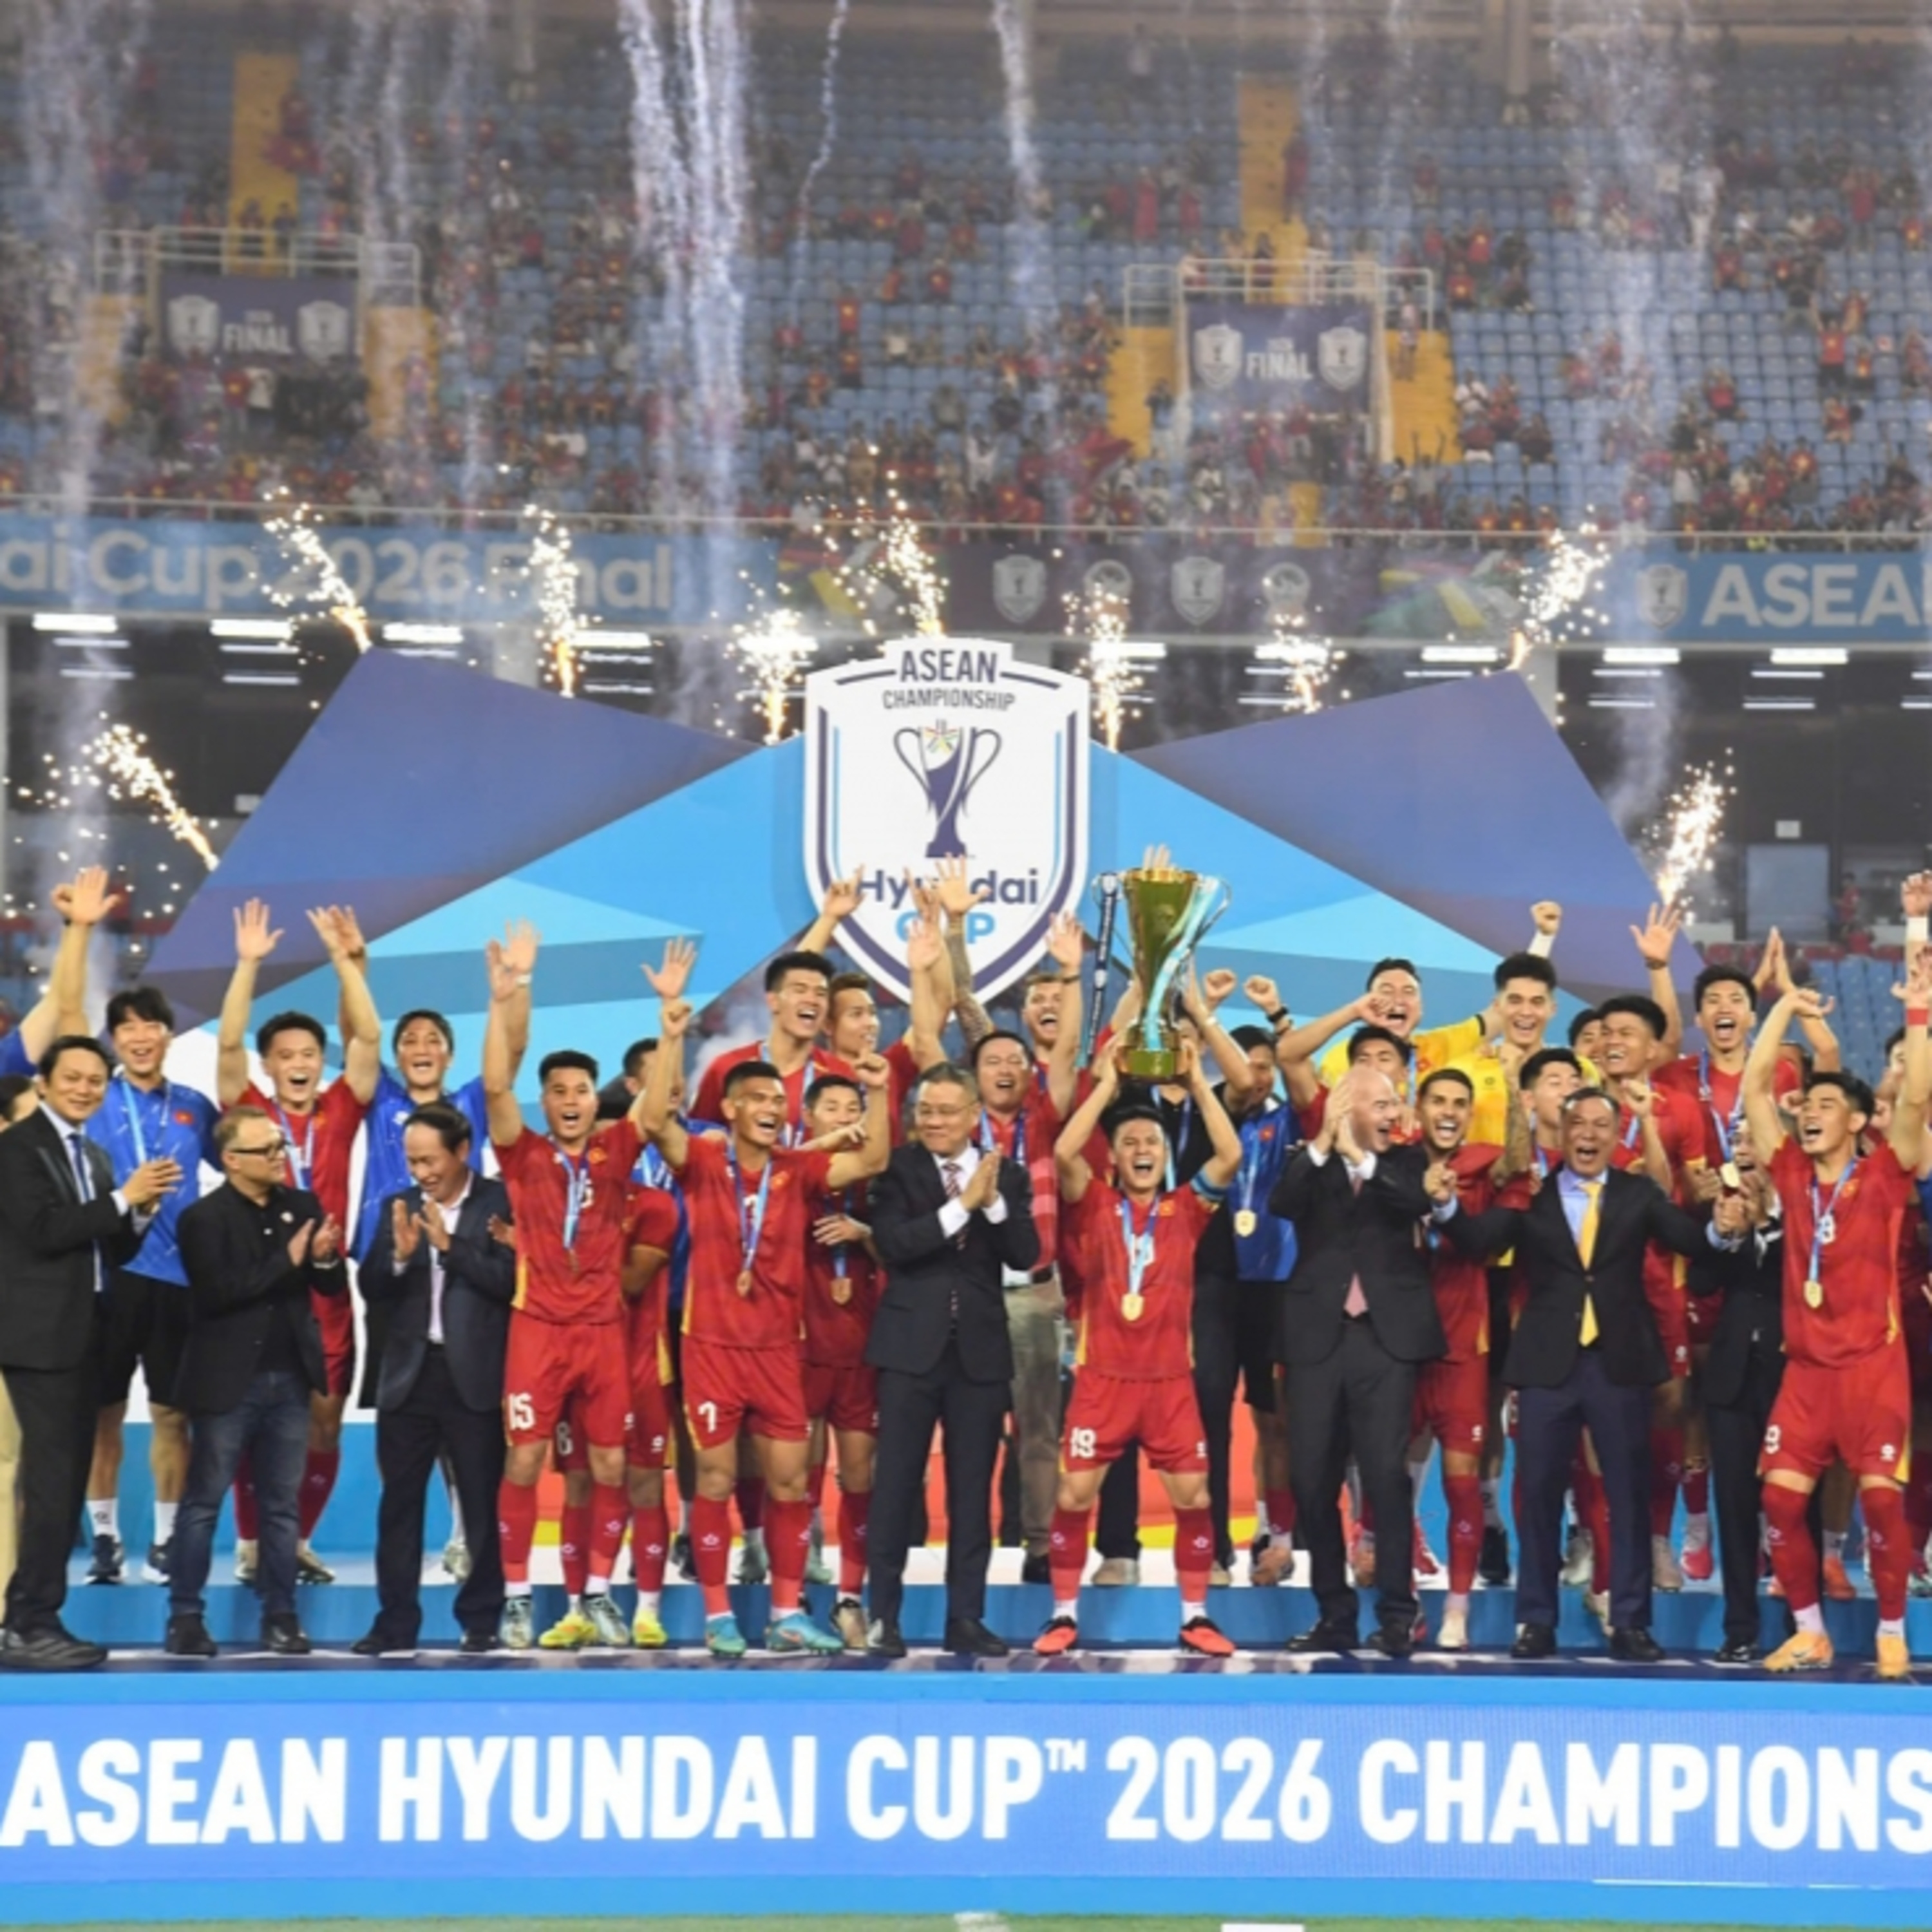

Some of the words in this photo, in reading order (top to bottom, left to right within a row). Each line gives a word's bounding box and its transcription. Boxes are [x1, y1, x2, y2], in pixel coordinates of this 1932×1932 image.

[223, 323, 294, 354] FINAL
[1247, 352, 1313, 379] FINAL
[90, 528, 259, 611] Cup
[484, 544, 671, 610] Fnal
[900, 649, 998, 683] ASEAN
[882, 688, 1016, 711] CHAMPIONSHIP
[857, 867, 1039, 910] Hydai
[895, 910, 996, 945] CP
[508, 1393, 535, 1430] 15
[698, 1401, 717, 1434] 7
[1070, 1426, 1096, 1459] 19
[0, 1738, 347, 1847] ASEAN
[379, 1735, 818, 1842] HYUNDAI
[1105, 1736, 1332, 1843] 2026
[1359, 1738, 1932, 1855] CHAMPIONS
